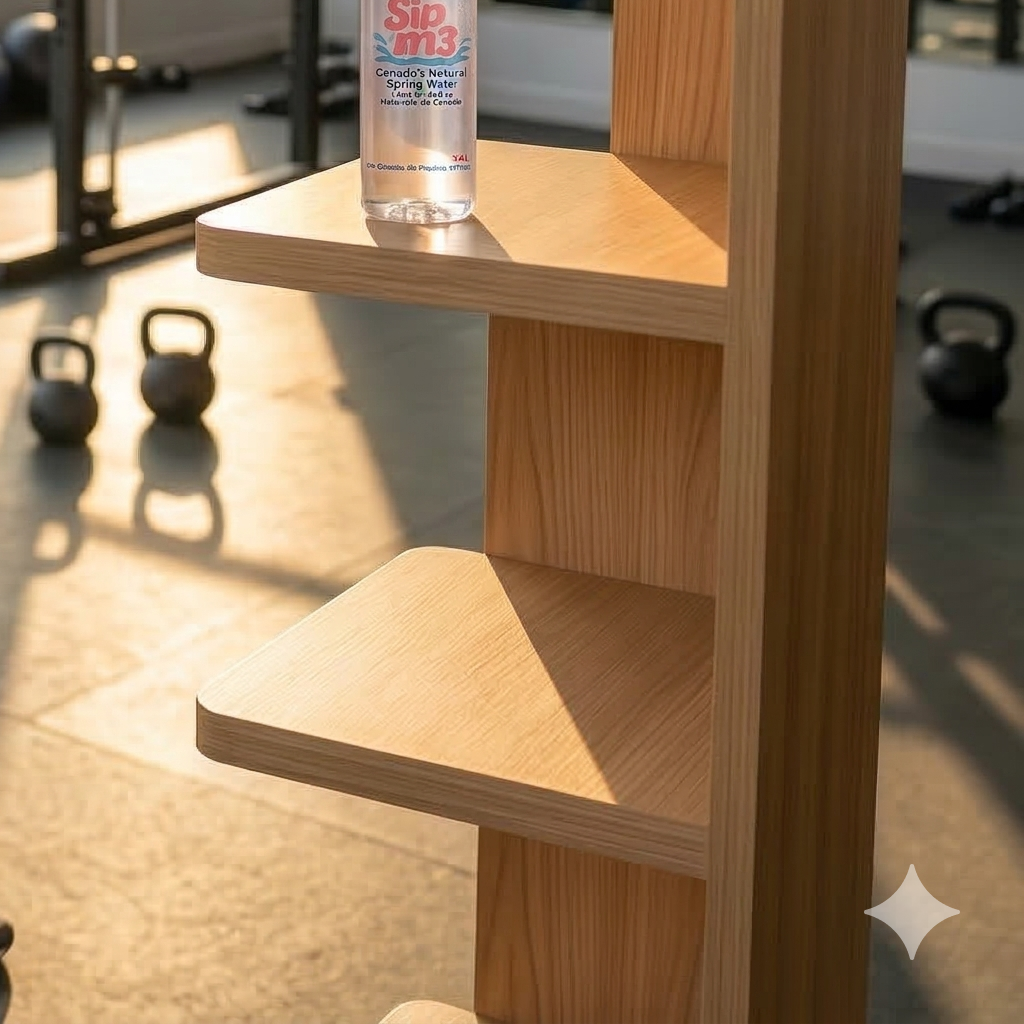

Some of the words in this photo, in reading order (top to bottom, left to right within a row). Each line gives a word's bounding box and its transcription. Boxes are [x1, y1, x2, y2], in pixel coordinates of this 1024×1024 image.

[393, 26, 458, 57] m3
[386, 79, 423, 91] Spring
[426, 79, 458, 89] Water
